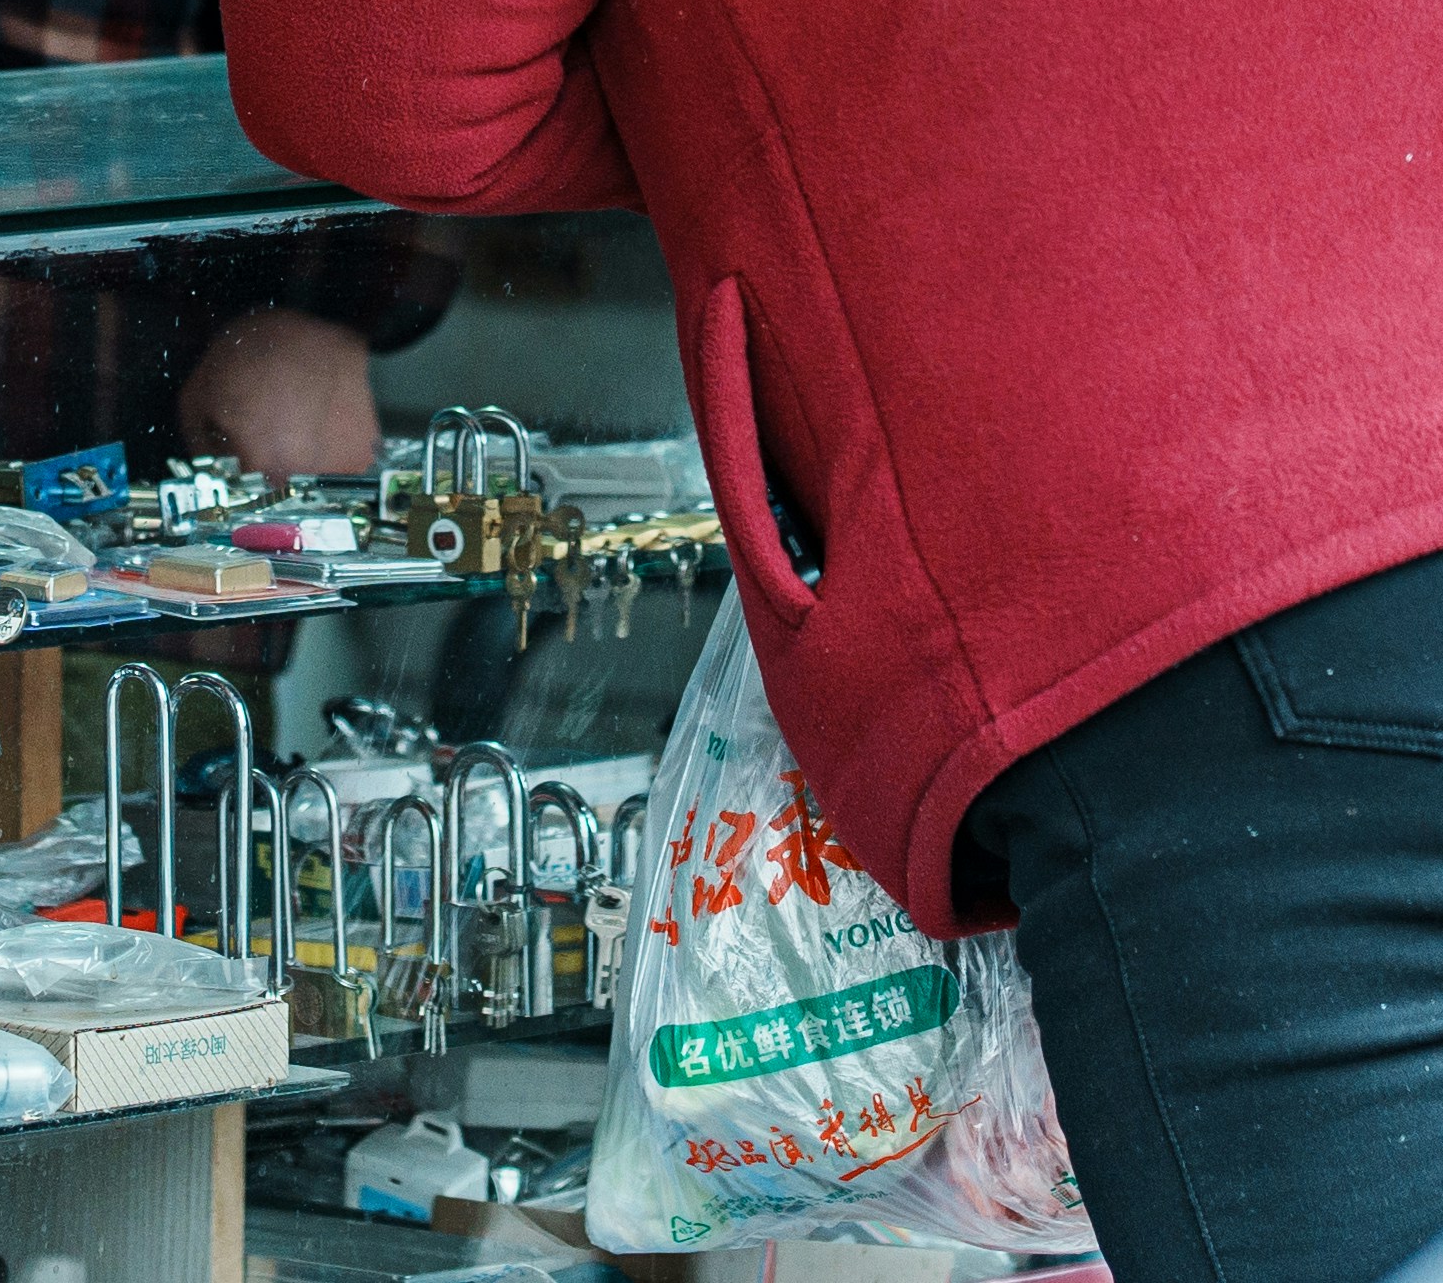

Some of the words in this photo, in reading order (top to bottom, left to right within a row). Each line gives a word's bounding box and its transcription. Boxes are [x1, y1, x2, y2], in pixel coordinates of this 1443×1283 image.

[677, 986, 914, 1078] 名优鲜食连锁
